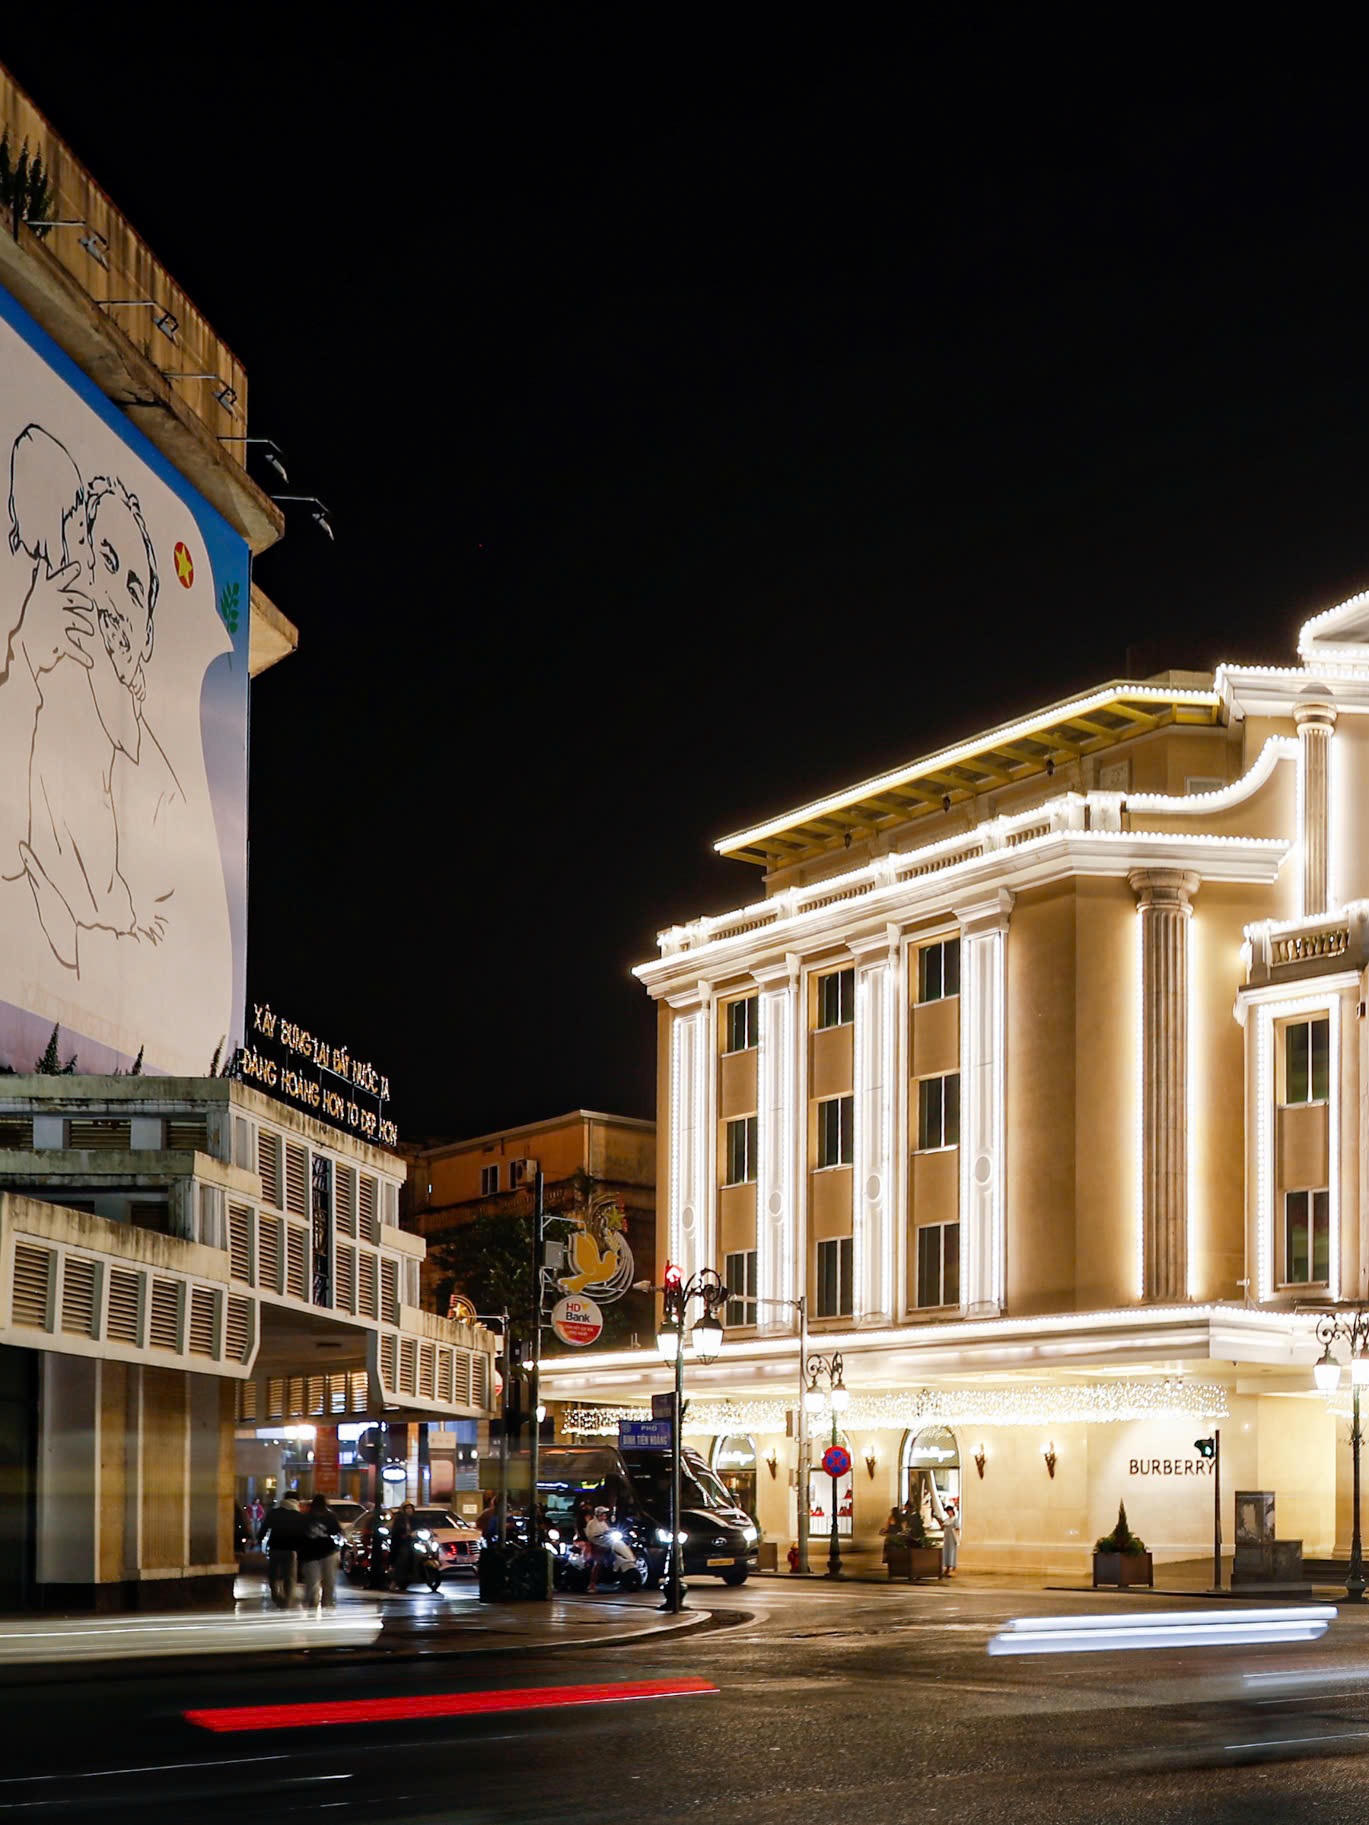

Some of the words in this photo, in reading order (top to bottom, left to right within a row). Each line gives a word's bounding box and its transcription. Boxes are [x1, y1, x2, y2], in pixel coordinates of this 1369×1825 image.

[566, 1302, 581, 1312] HD
[566, 1311, 591, 1323] Bank
[1128, 1458, 1217, 1476] BURBERRY
